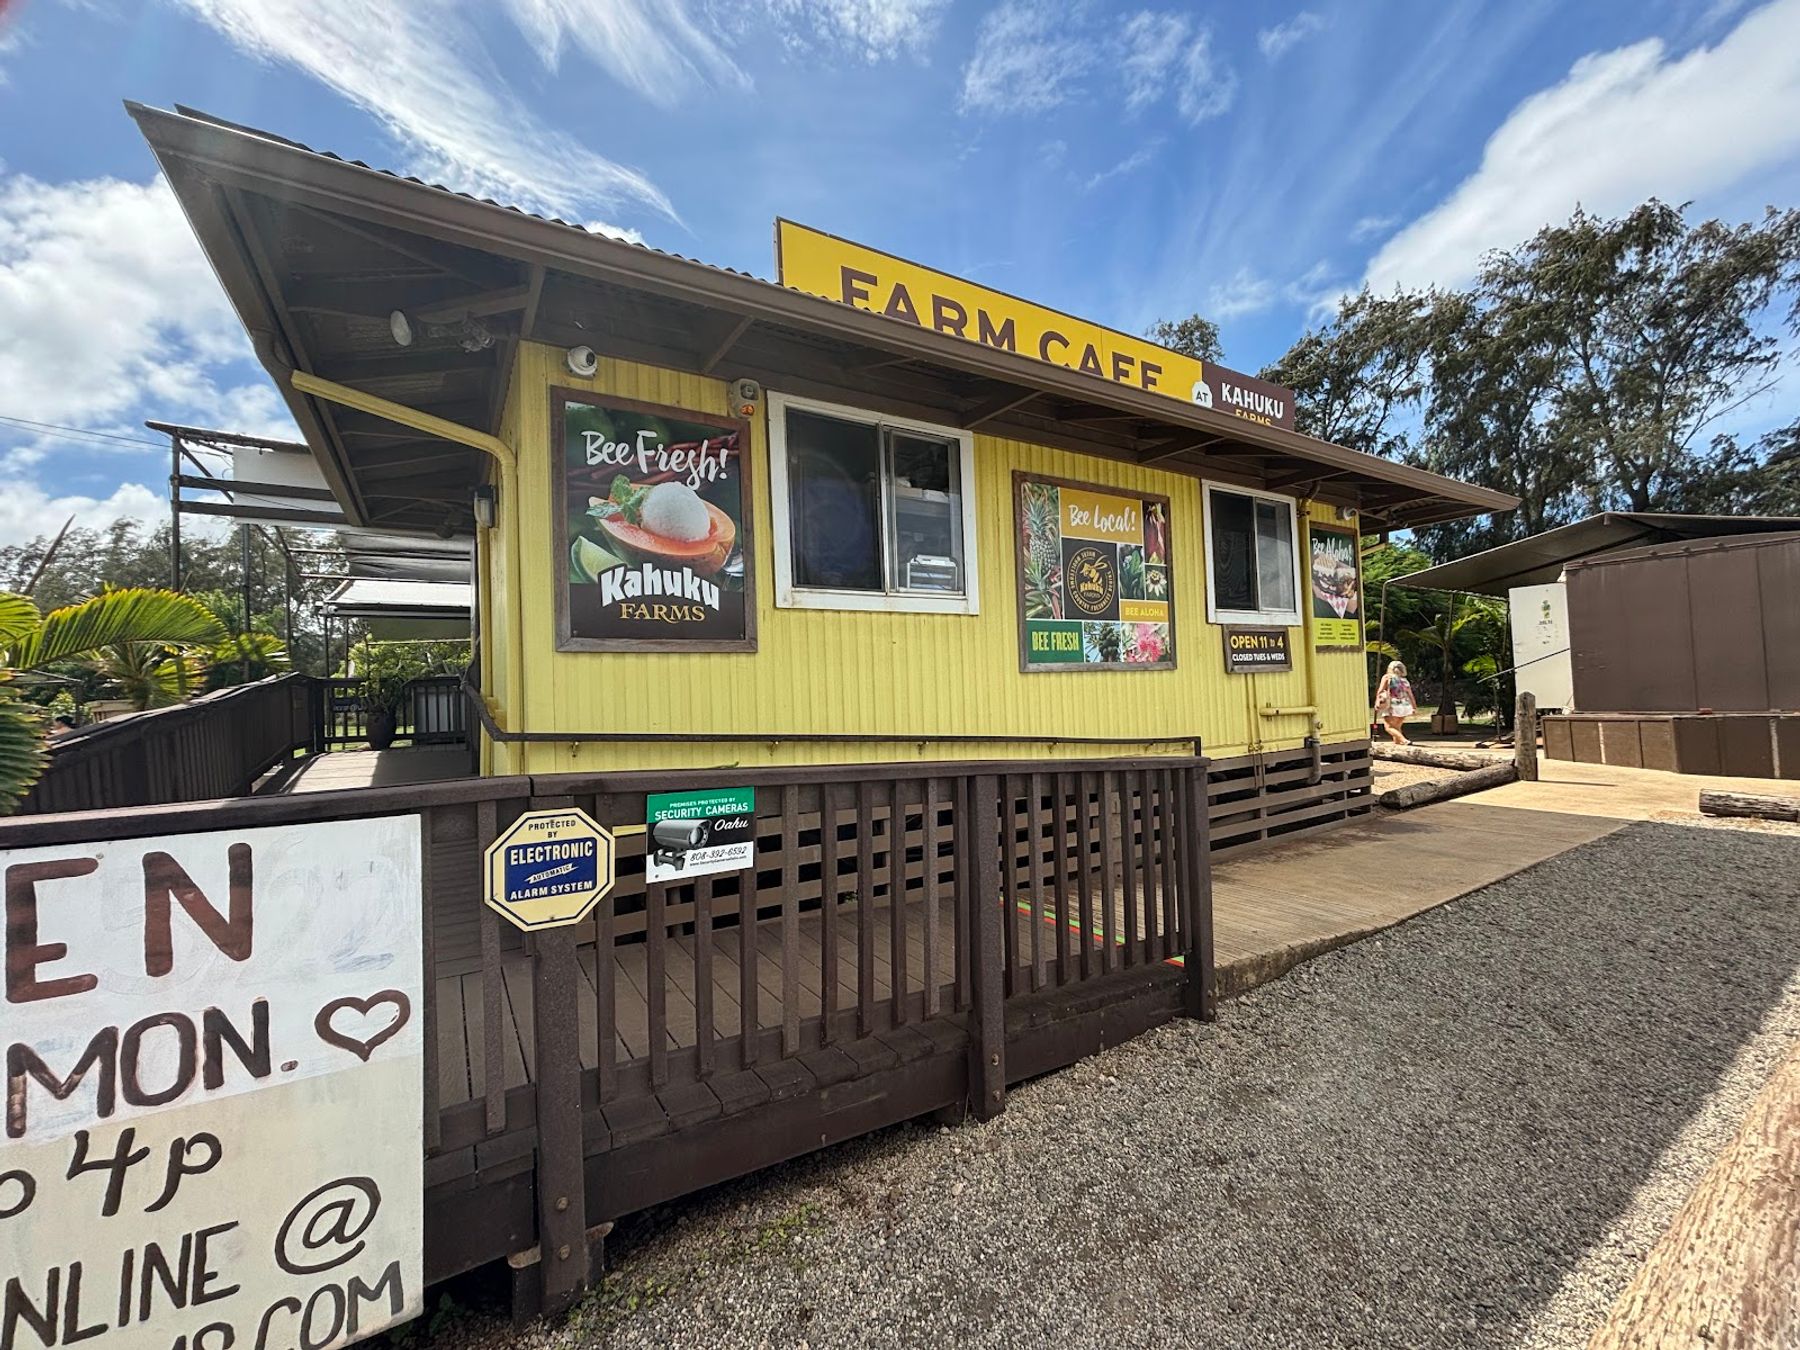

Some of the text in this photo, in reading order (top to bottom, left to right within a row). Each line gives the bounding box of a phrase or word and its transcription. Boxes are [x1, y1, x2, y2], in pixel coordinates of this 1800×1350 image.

[841, 266, 1162, 390] FARM CAFE
[1196, 391, 1208, 403] AT
[1221, 382, 1284, 419] KAHUKU
[581, 430, 728, 490] Bee Fresh!
[1068, 504, 1136, 533] Bee Local!
[601, 563, 720, 611] Kahuku
[620, 603, 705, 623] FARMS
[1125, 607, 1164, 617] BEE ALOHA
[1032, 631, 1079, 651] BEE FRESH
[1230, 635, 1258, 649] OPEN
[1260, 636, 1267, 648] 11
[1277, 636, 1283, 648] 4
[1232, 653, 1253, 661] CLOSED
[1253, 653, 1266, 661] TUES
[655, 802, 749, 821] SECURITY CAMERAS
[669, 800, 696, 808] PREMISES
[697, 798, 728, 806] PROTECTED
[528, 820, 576, 831] PROTECTED
[714, 817, 749, 831] Oahu
[547, 831, 558, 839] BY
[510, 841, 593, 865] ELECTRONIC
[532, 864, 570, 881] AUTOMATIC
[510, 881, 593, 900] ALARM SYSTEM
[6, 997, 298, 1138] MON.
[66, 1128, 222, 1217] 4p
[275, 1176, 382, 1275] @
